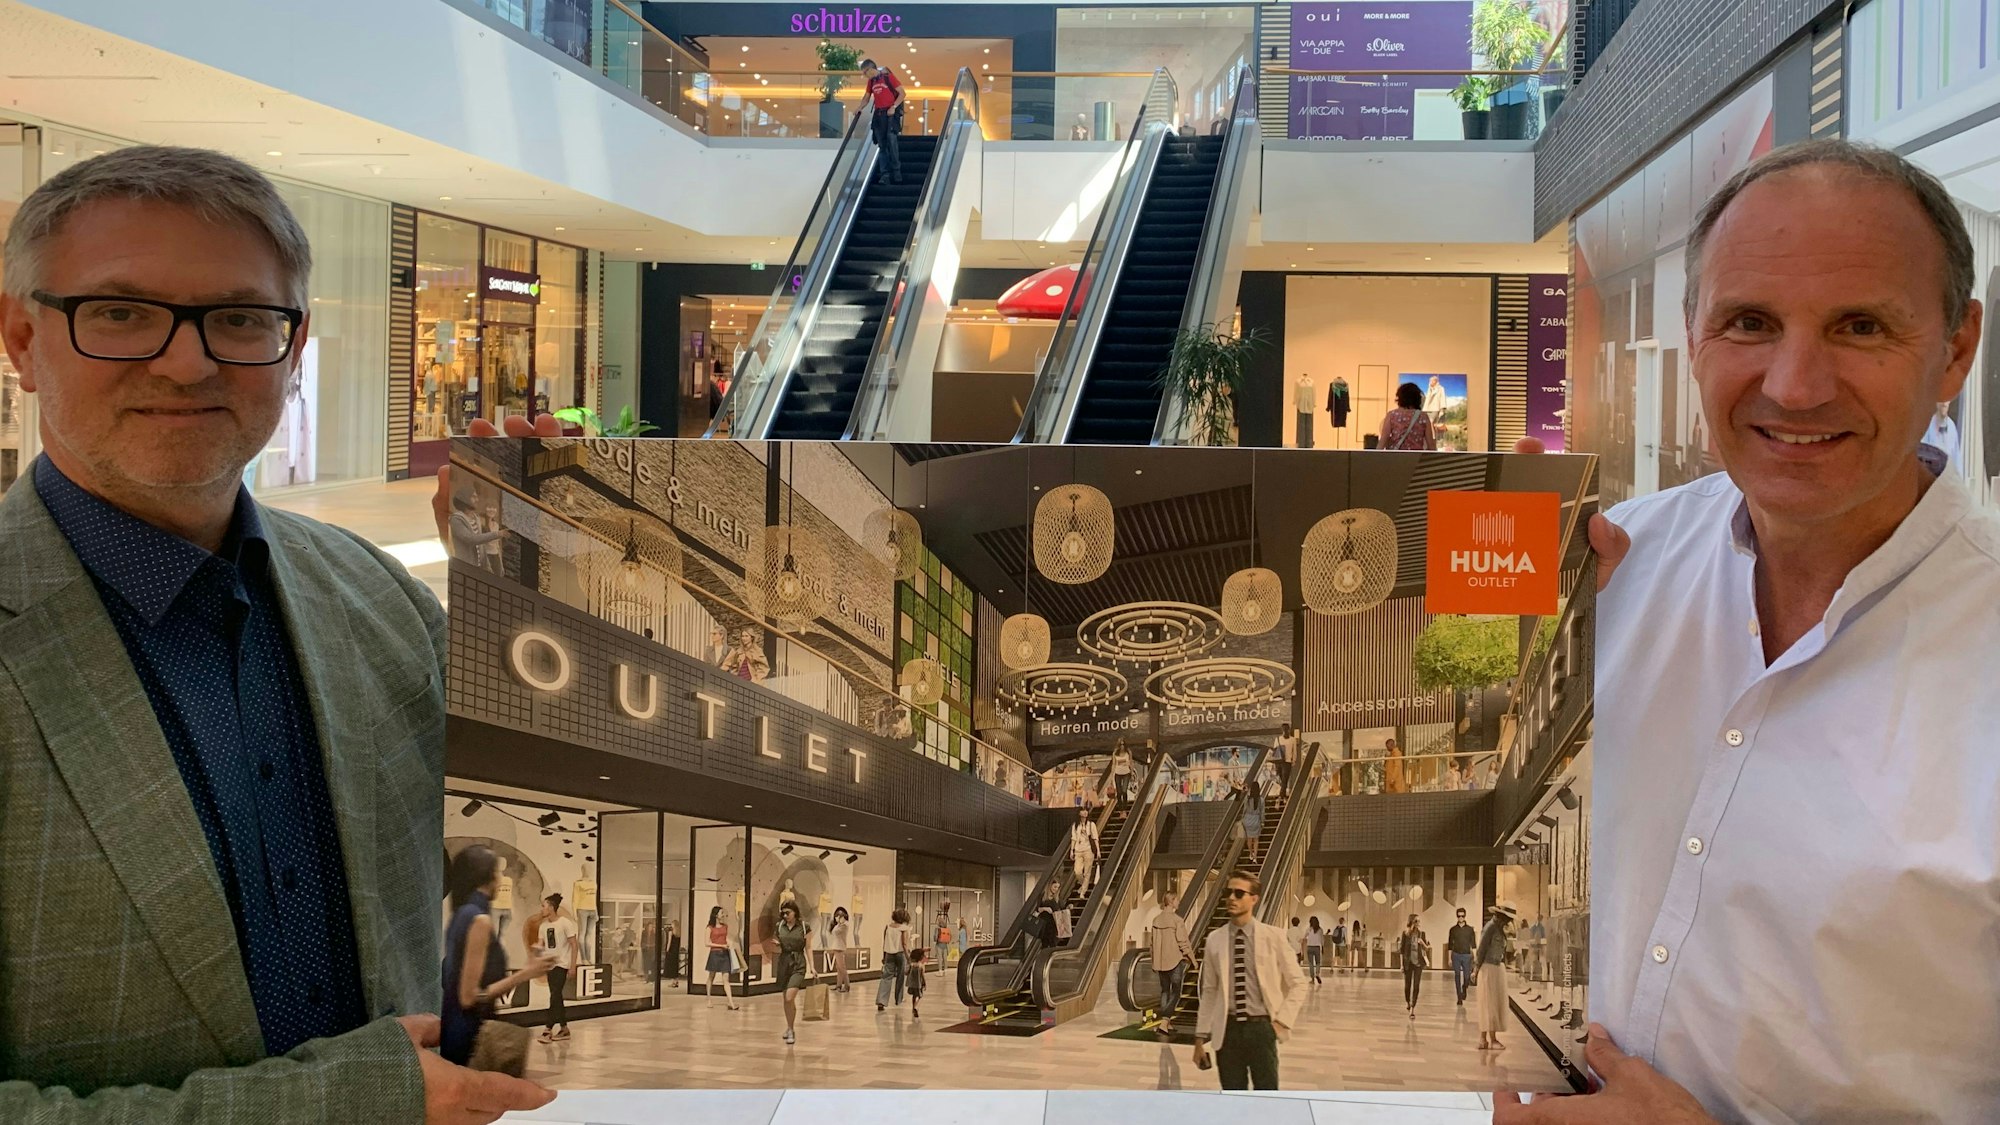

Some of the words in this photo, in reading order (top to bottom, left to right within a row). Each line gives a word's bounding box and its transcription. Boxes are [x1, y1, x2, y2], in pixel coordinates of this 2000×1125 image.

[790, 8, 901, 33] schulze:
[1306, 8, 1340, 21] oui
[1366, 38, 1405, 52] s.Oliver
[667, 475, 685, 509] &
[1450, 550, 1537, 573] HUMA
[1468, 577, 1518, 587] OUTLET
[839, 594, 850, 617] &
[512, 631, 867, 784] OUTLET
[1317, 694, 1436, 715] Accessories
[1040, 722, 1091, 736] Herren
[1097, 717, 1140, 731] mode
[1168, 709, 1227, 726] Damen
[1233, 706, 1281, 720] mode
